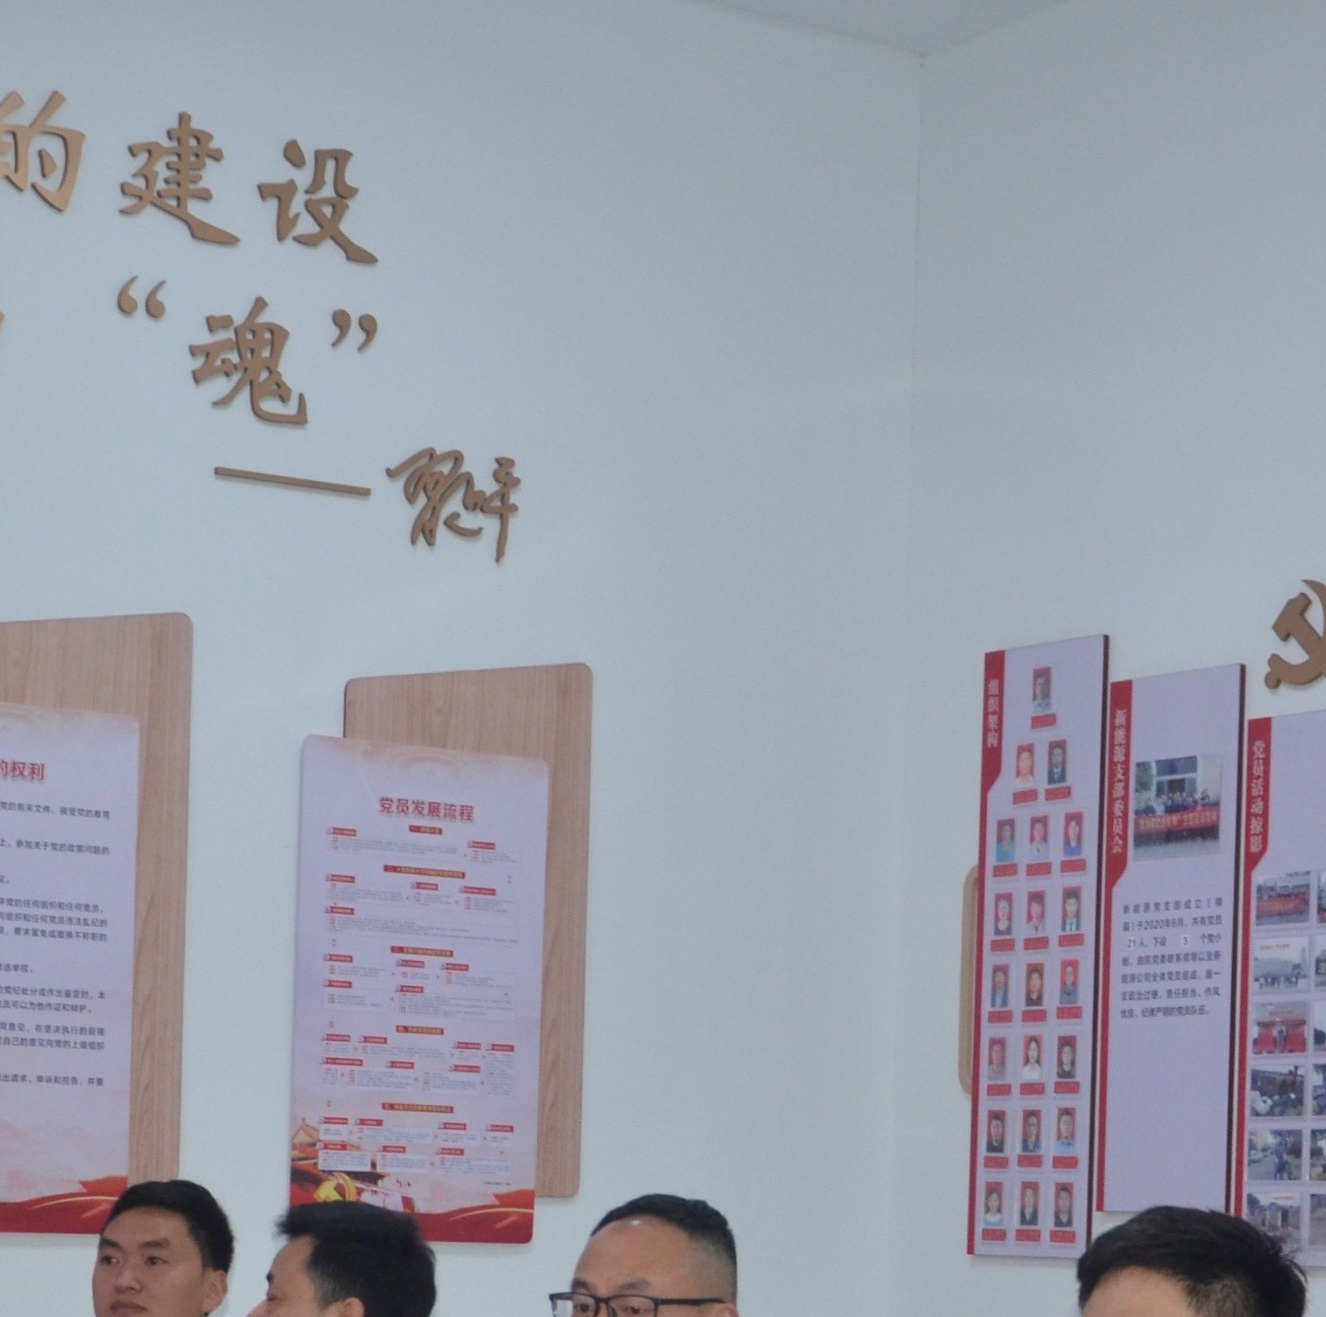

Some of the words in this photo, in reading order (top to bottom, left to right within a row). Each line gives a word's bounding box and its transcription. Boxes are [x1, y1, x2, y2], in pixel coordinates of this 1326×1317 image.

[379, 796, 474, 822] 党员发展流程
